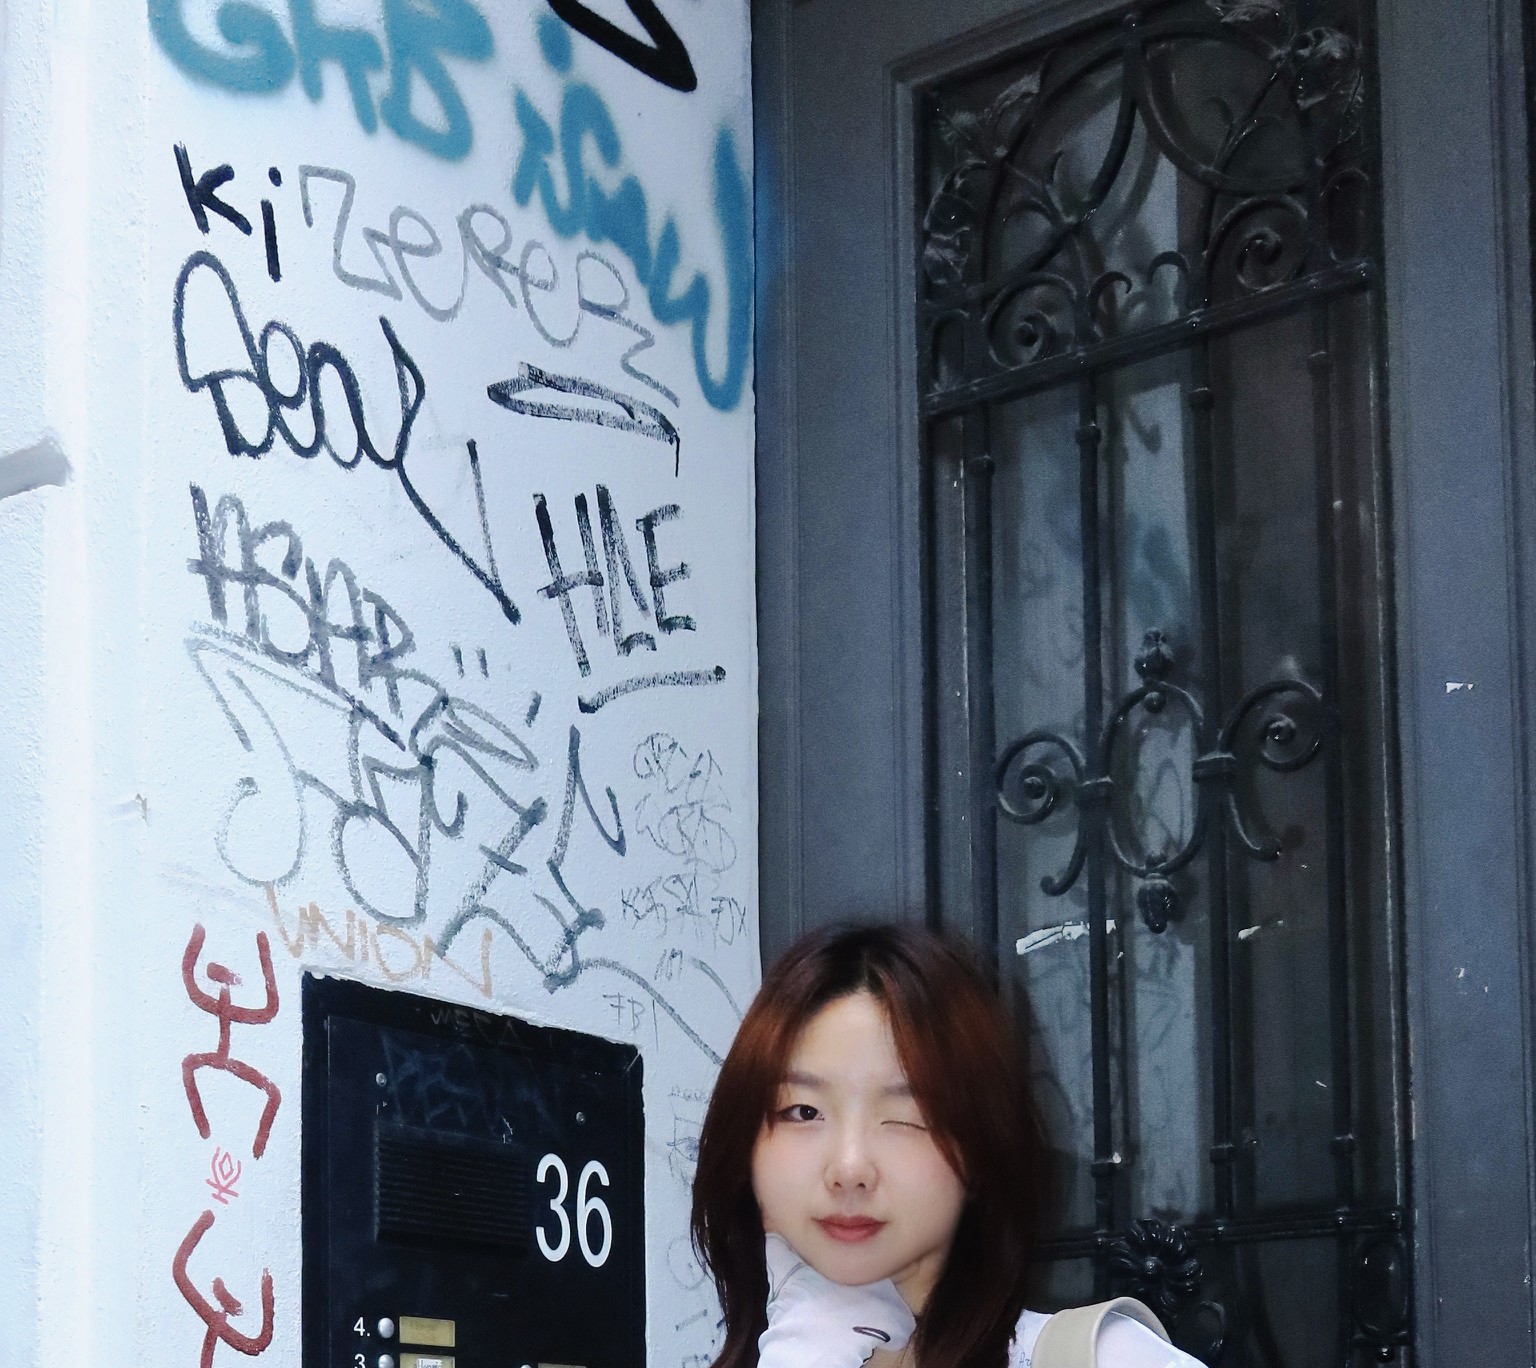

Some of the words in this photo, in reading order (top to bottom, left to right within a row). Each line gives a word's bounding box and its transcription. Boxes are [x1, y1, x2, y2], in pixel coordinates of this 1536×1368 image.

[264, 880, 493, 999] UNION
[536, 1152, 613, 1268] 36
[353, 1316, 371, 1337] 4.
